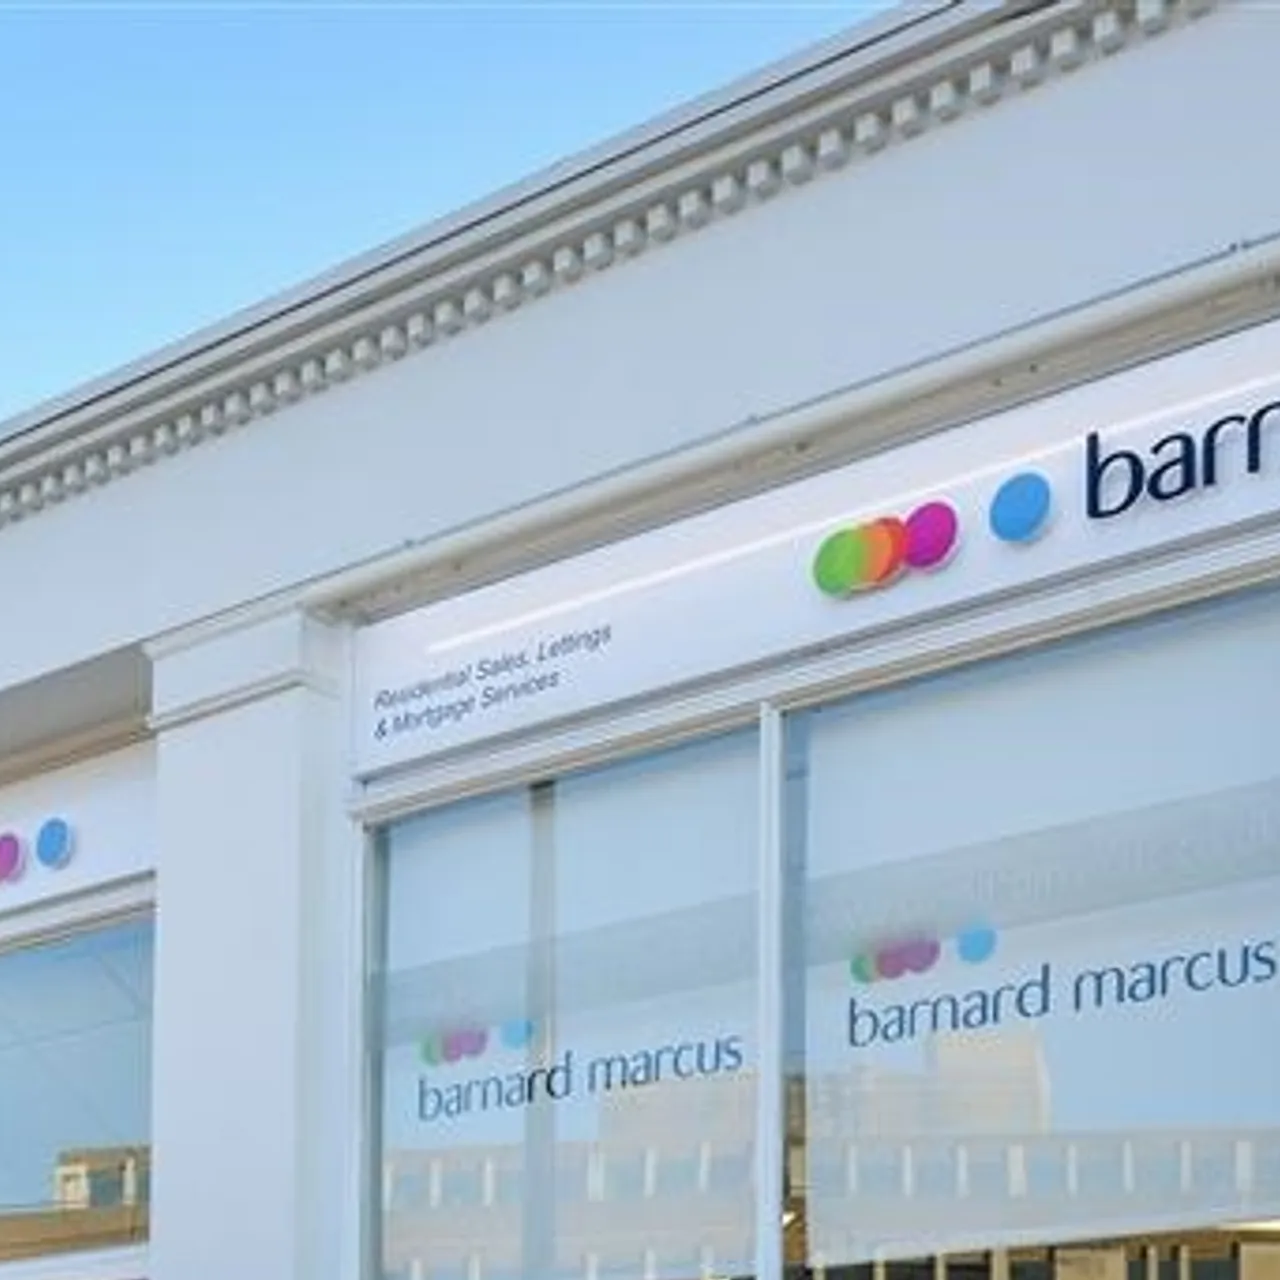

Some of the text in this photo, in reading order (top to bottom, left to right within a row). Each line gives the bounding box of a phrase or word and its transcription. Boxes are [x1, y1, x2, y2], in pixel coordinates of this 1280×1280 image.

[374, 663, 472, 711] Residential
[536, 624, 612, 662] Lettings
[392, 694, 476, 730] Mortgage
[480, 671, 560, 709] Services
[847, 937, 1279, 1048] barnard marcus
[418, 1033, 744, 1122] barnard marcus
